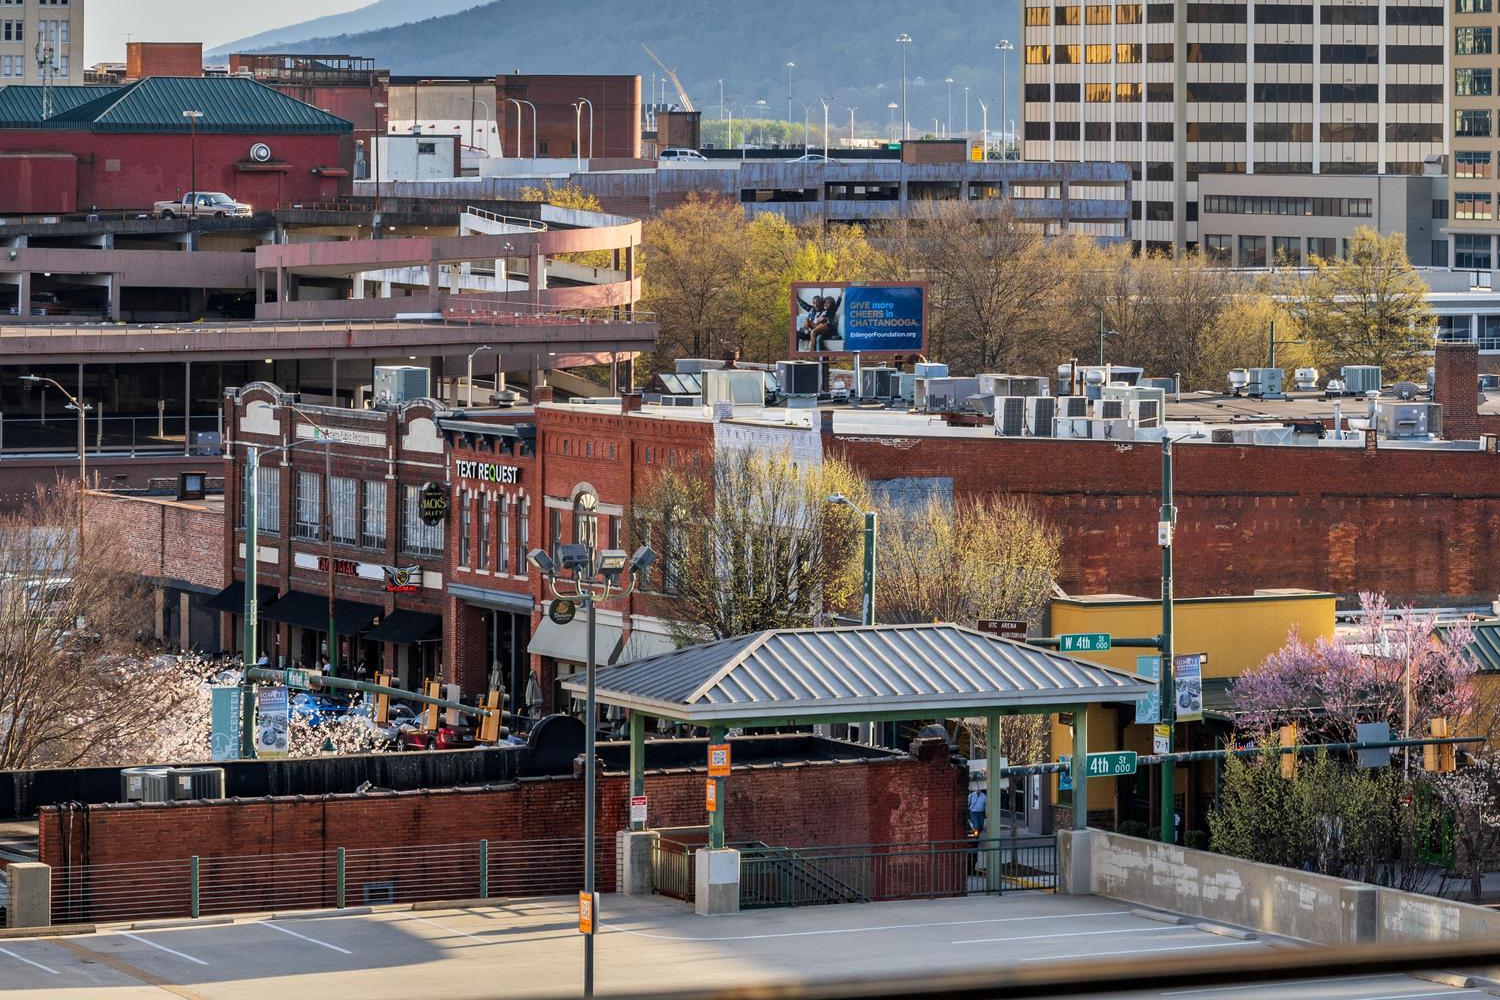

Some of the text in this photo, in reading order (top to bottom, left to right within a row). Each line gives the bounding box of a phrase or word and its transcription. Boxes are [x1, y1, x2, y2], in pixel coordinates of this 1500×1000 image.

[850, 301, 894, 310] GIVE more
[850, 309, 894, 318] CHEERS in
[455, 459, 518, 484] TEXT REQUEST
[988, 621, 998, 629] UTC
[1065, 636, 1091, 650] W 4th
[1098, 635, 1105, 643] St
[230, 691, 239, 759] CITY CENTER
[1090, 756, 1109, 774] 4th
[1118, 755, 1127, 765] St
[1114, 763, 1131, 774] 000
